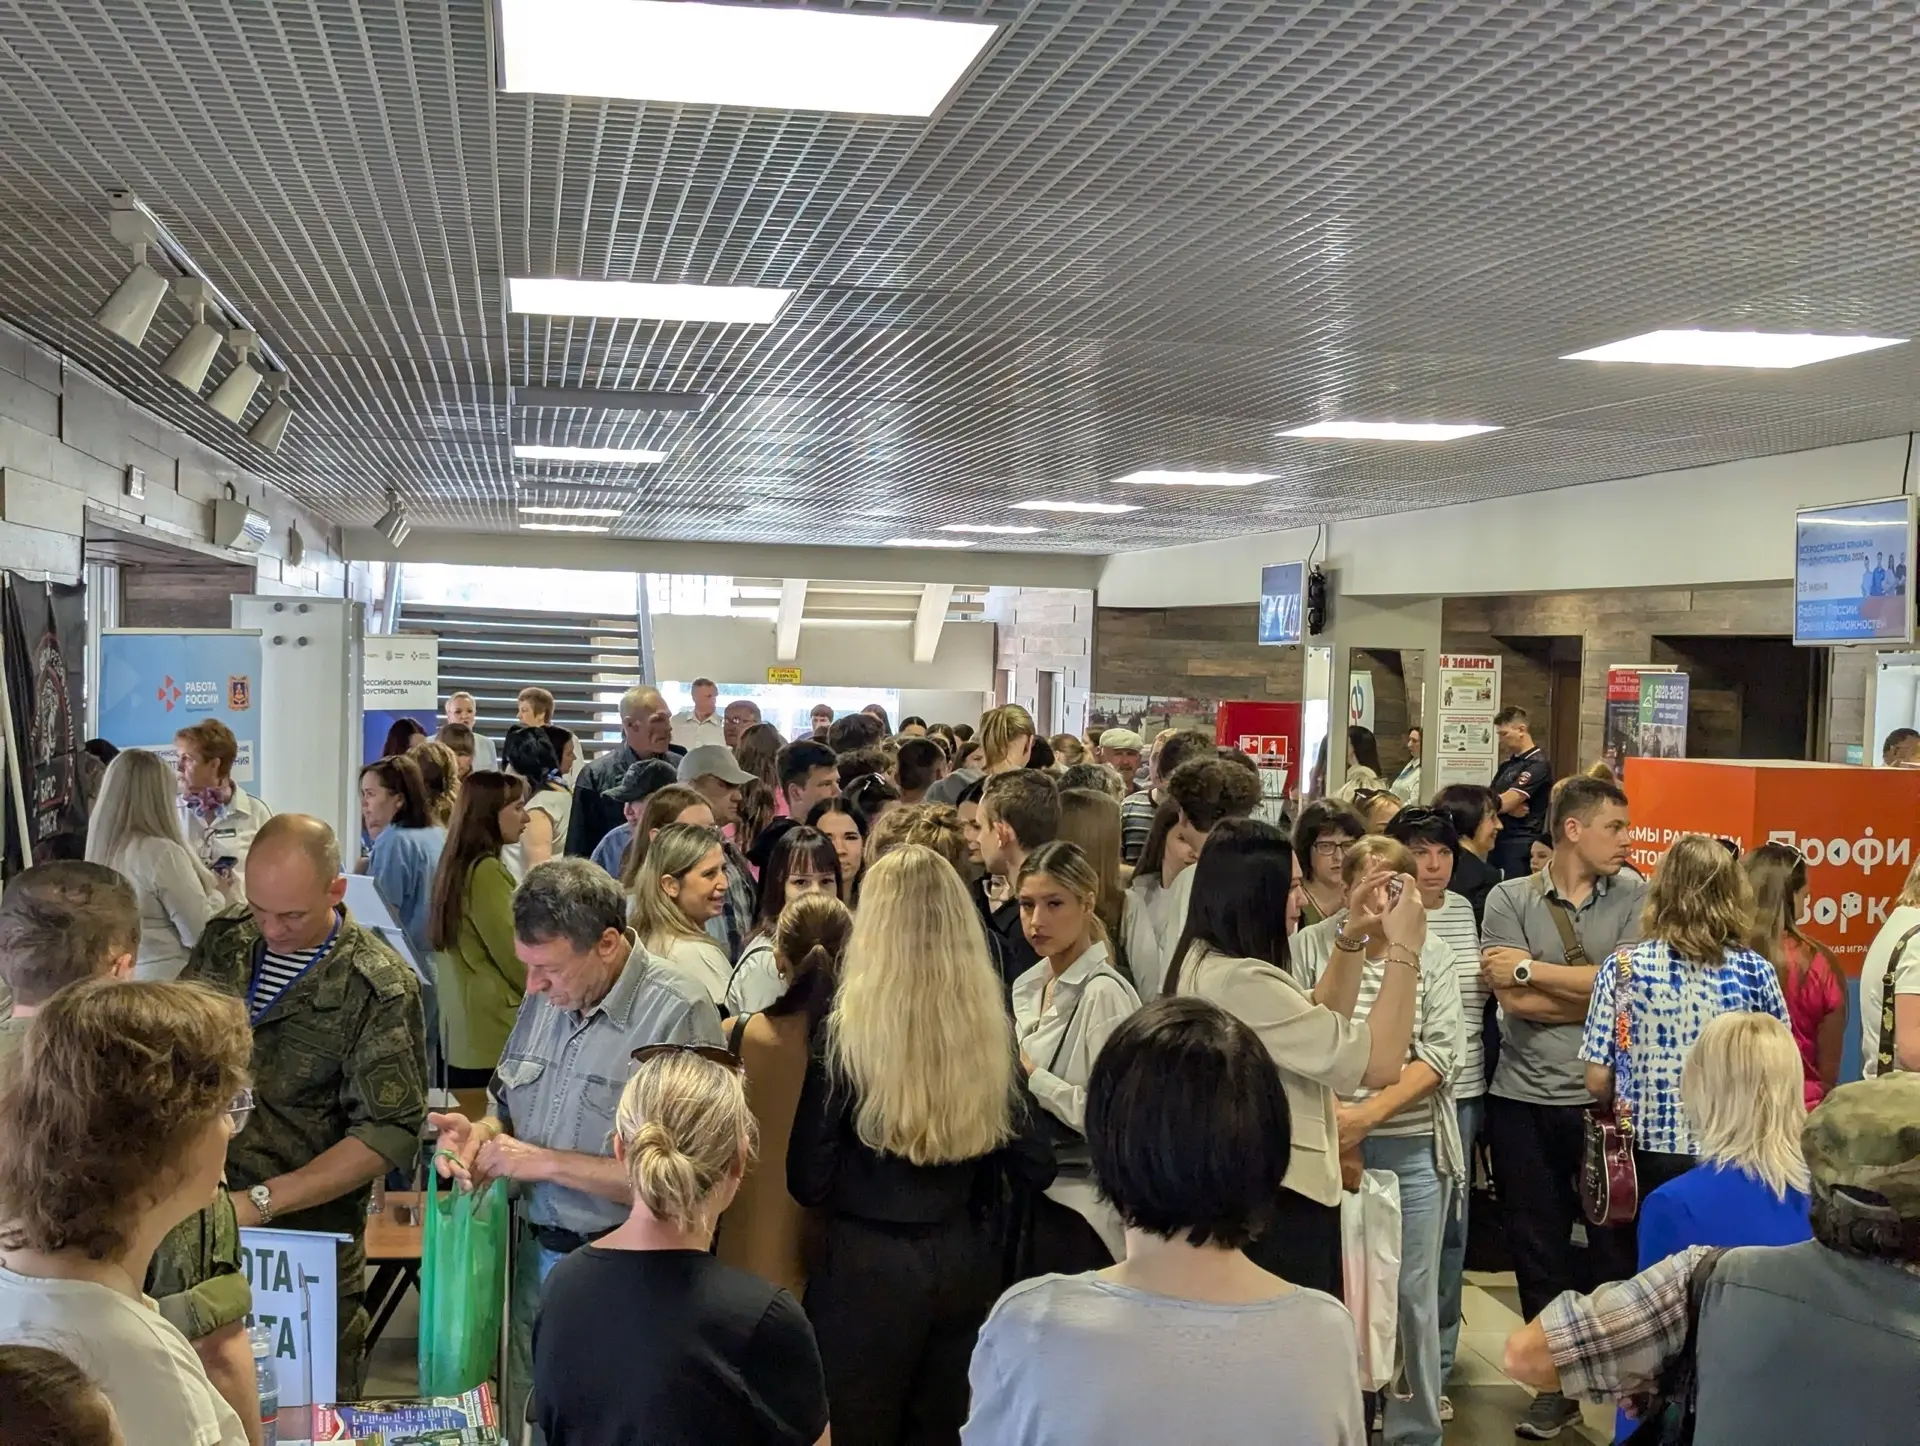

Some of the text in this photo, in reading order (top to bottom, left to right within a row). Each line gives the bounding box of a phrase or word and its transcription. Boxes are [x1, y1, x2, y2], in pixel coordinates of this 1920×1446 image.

[185, 682, 217, 692] РАБОТА
[185, 694, 219, 704] РОССИИ
[1628, 826, 1659, 843] «МЫ
[1847, 945, 1868, 953] ИГРА
[241, 1246, 294, 1293] ОТА
